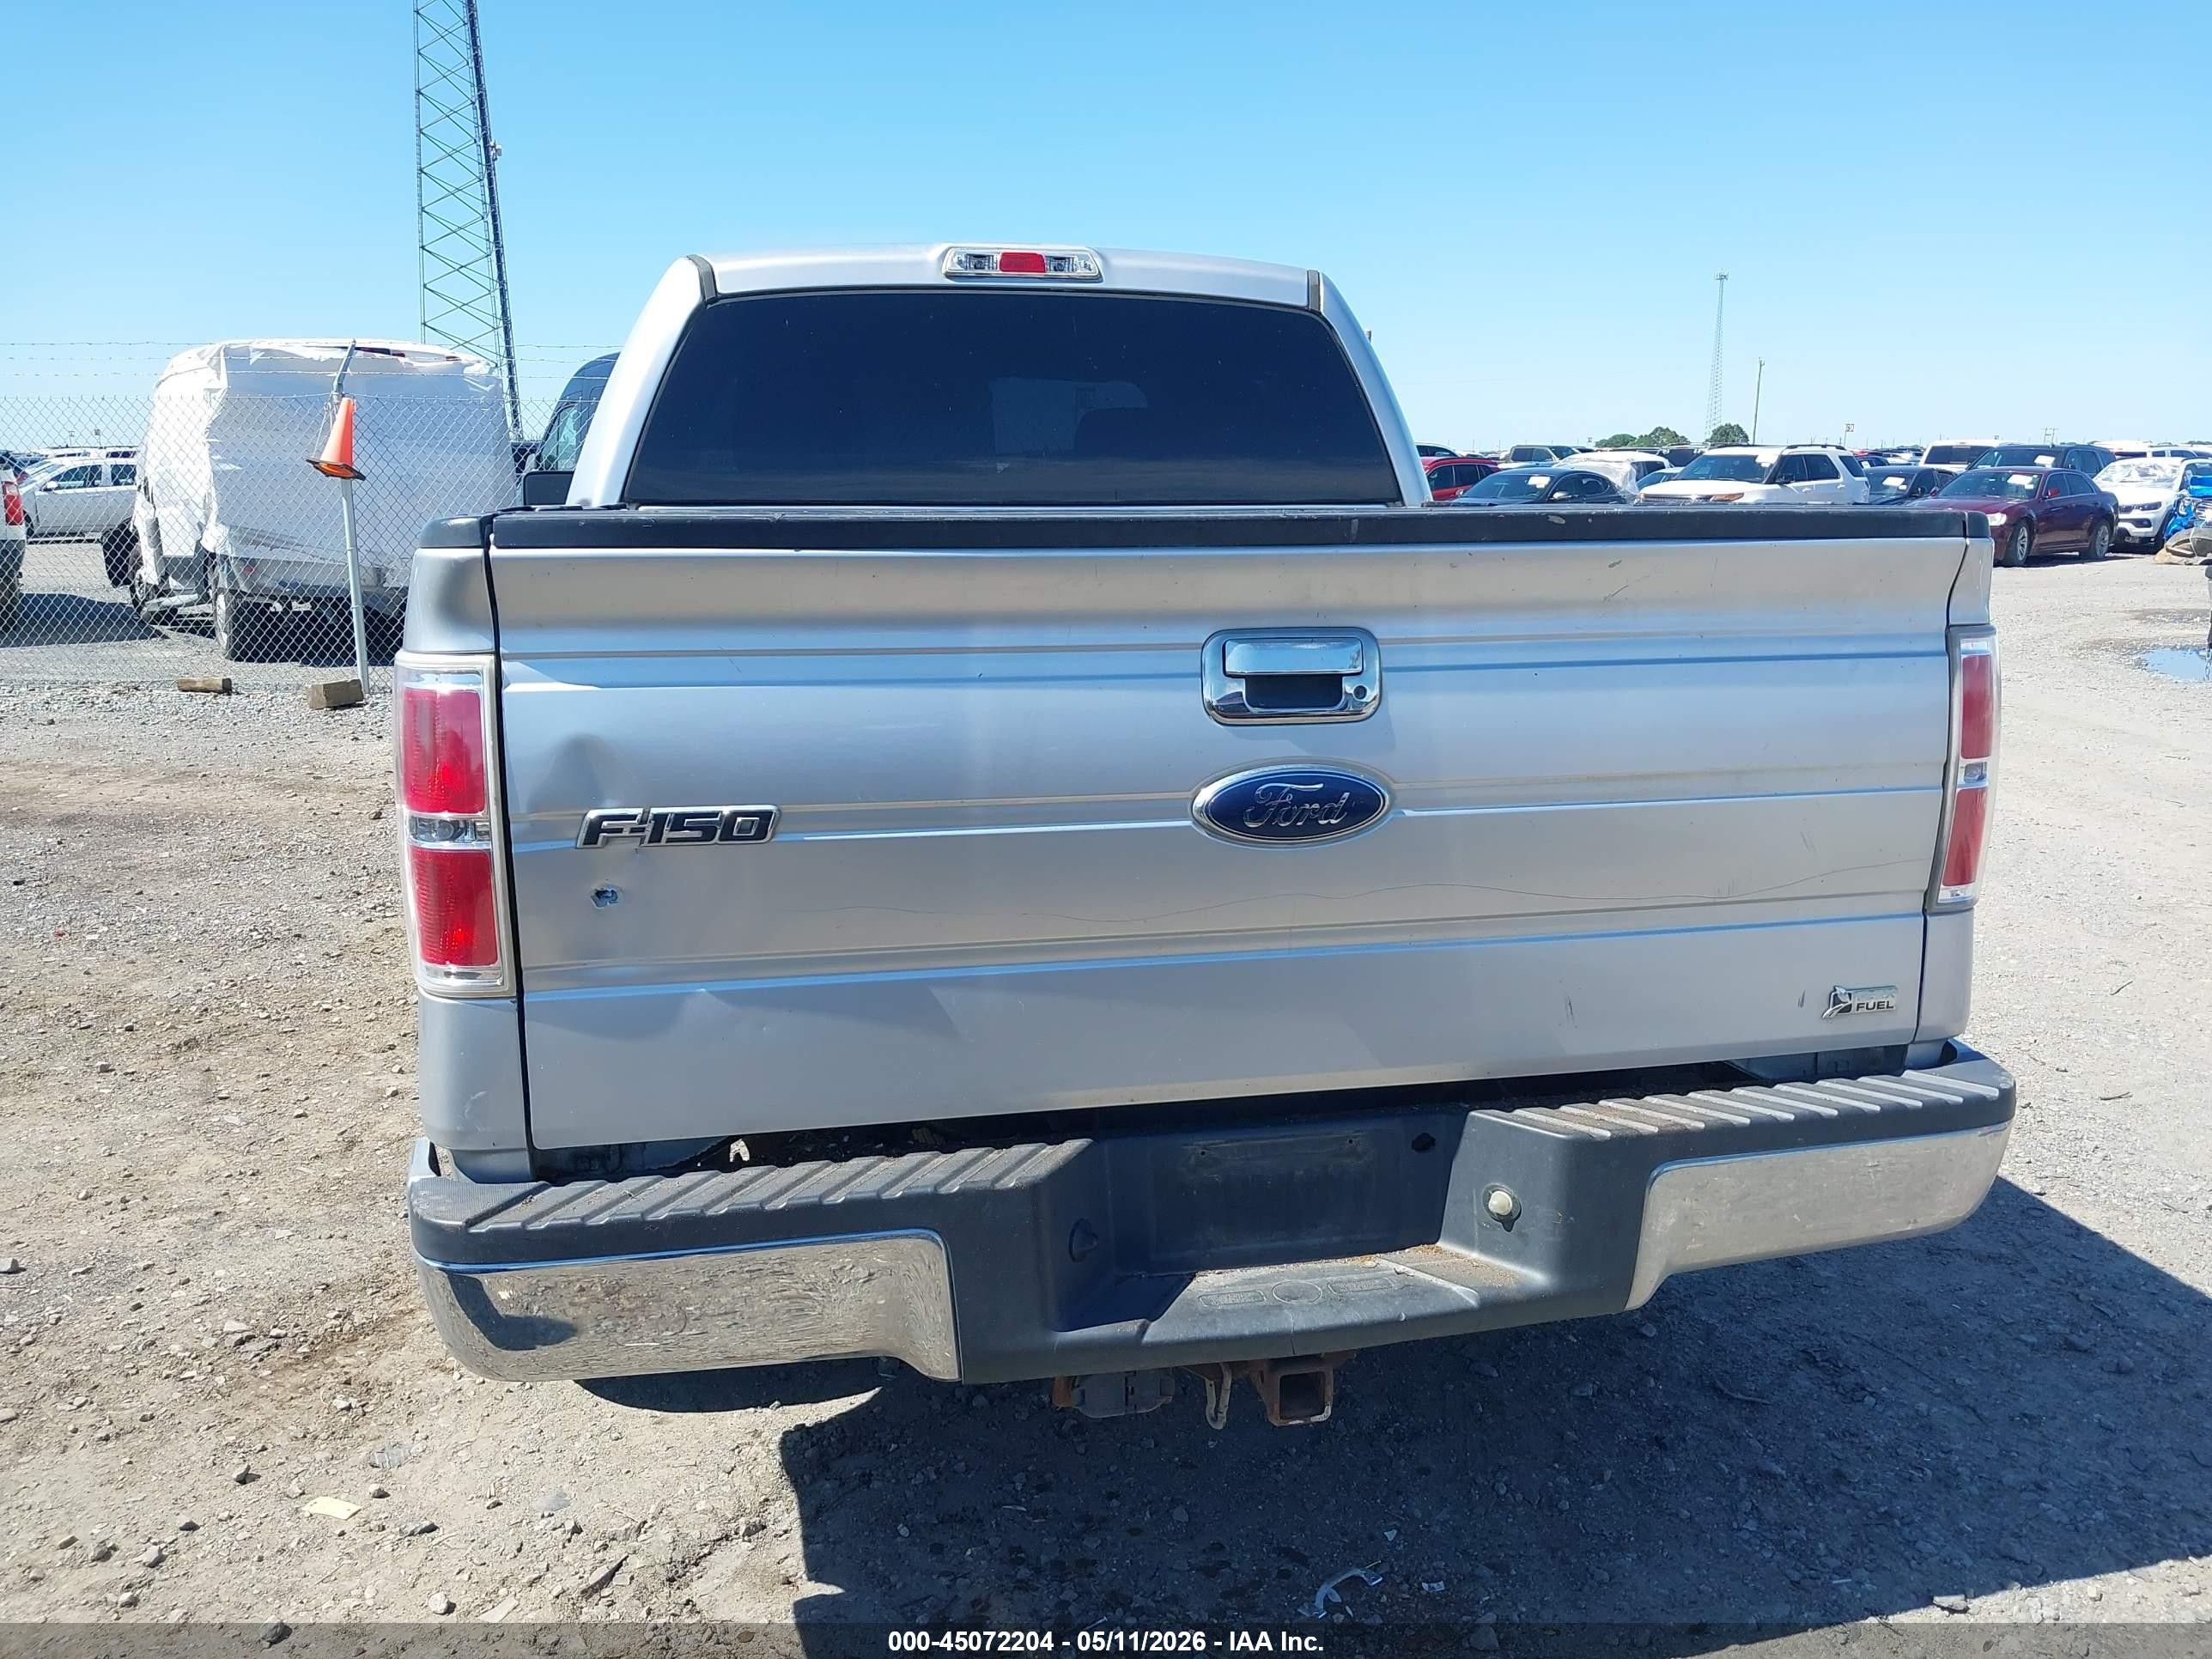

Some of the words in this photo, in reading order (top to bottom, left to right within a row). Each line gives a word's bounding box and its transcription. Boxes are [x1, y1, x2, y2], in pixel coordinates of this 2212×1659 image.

[575, 804, 782, 848] F-150
[1243, 782, 1351, 828] Ford
[1856, 1000, 1894, 1012] FUEL
